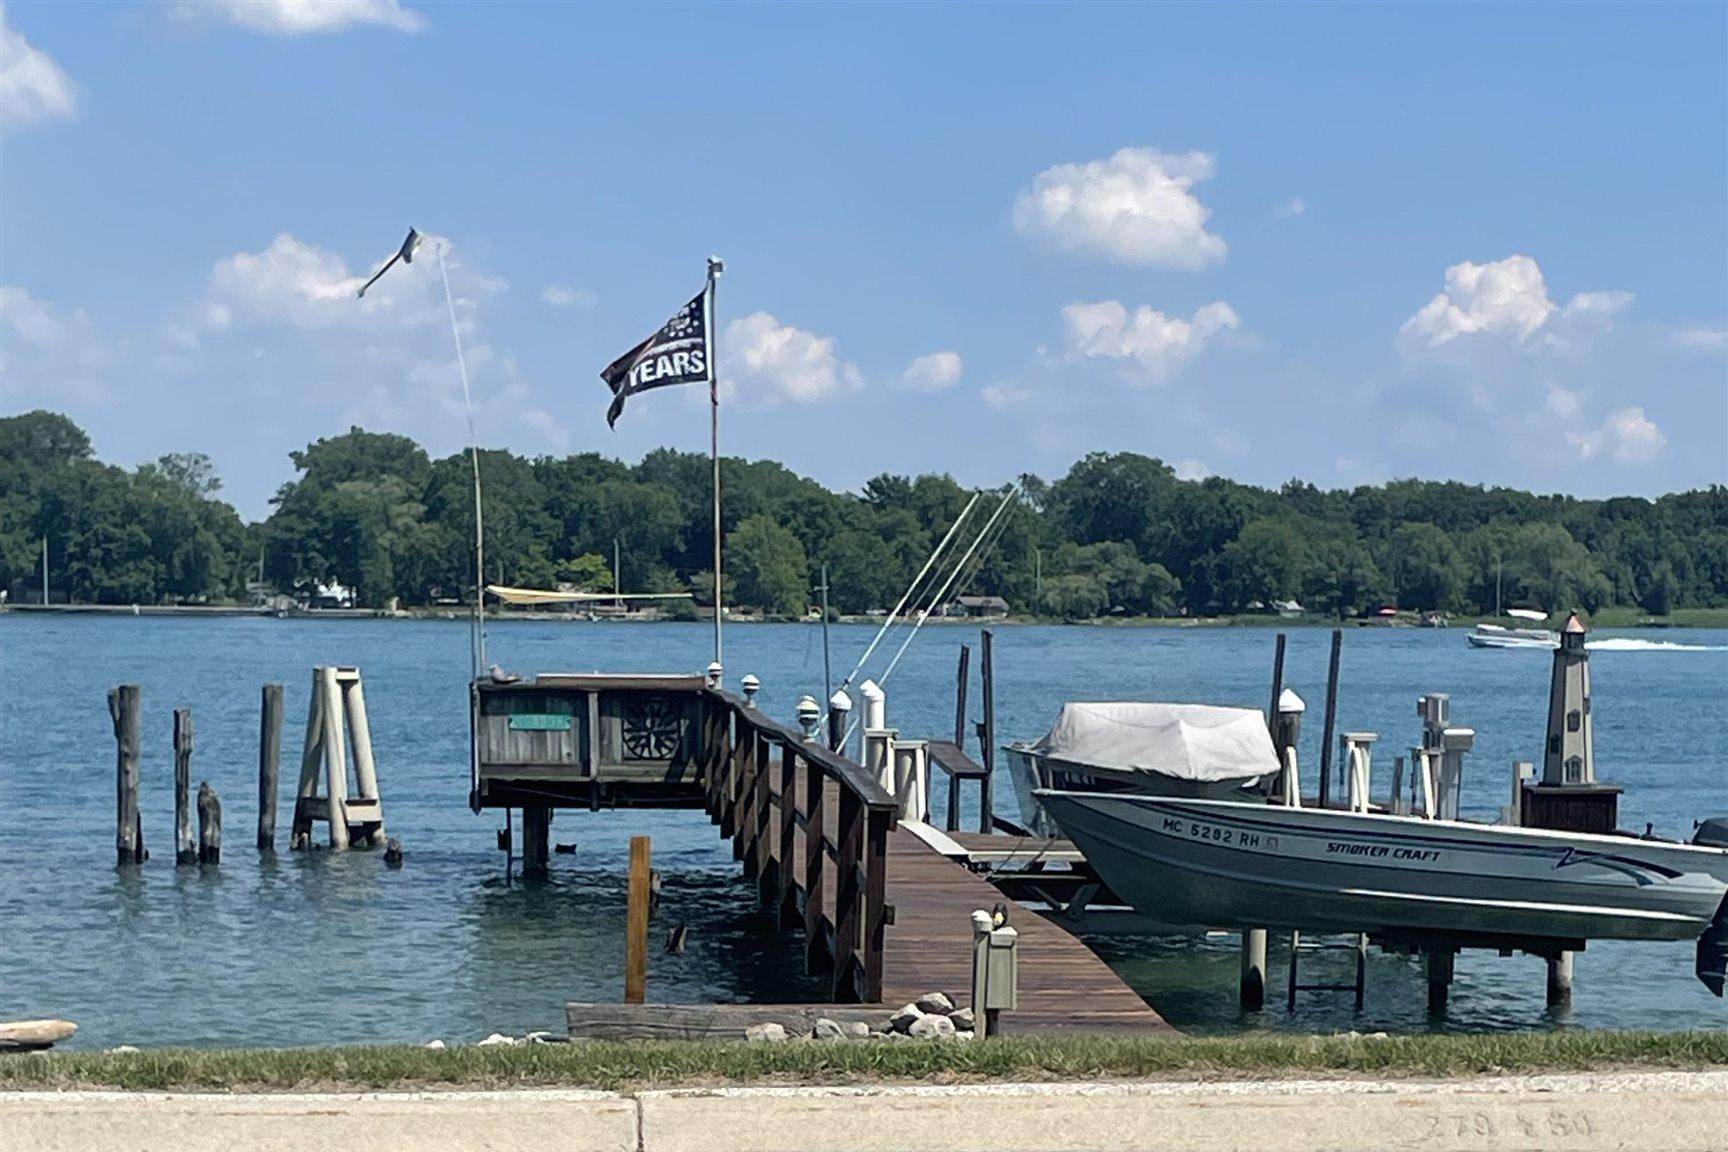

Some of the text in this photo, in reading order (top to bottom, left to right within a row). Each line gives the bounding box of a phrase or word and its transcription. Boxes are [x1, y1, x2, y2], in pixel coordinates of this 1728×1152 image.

[627, 350, 706, 388] YEARS
[1162, 818, 1183, 833] MC
[1239, 832, 1260, 847] RH
[1326, 842, 1441, 862] SMOKER CRAFT
